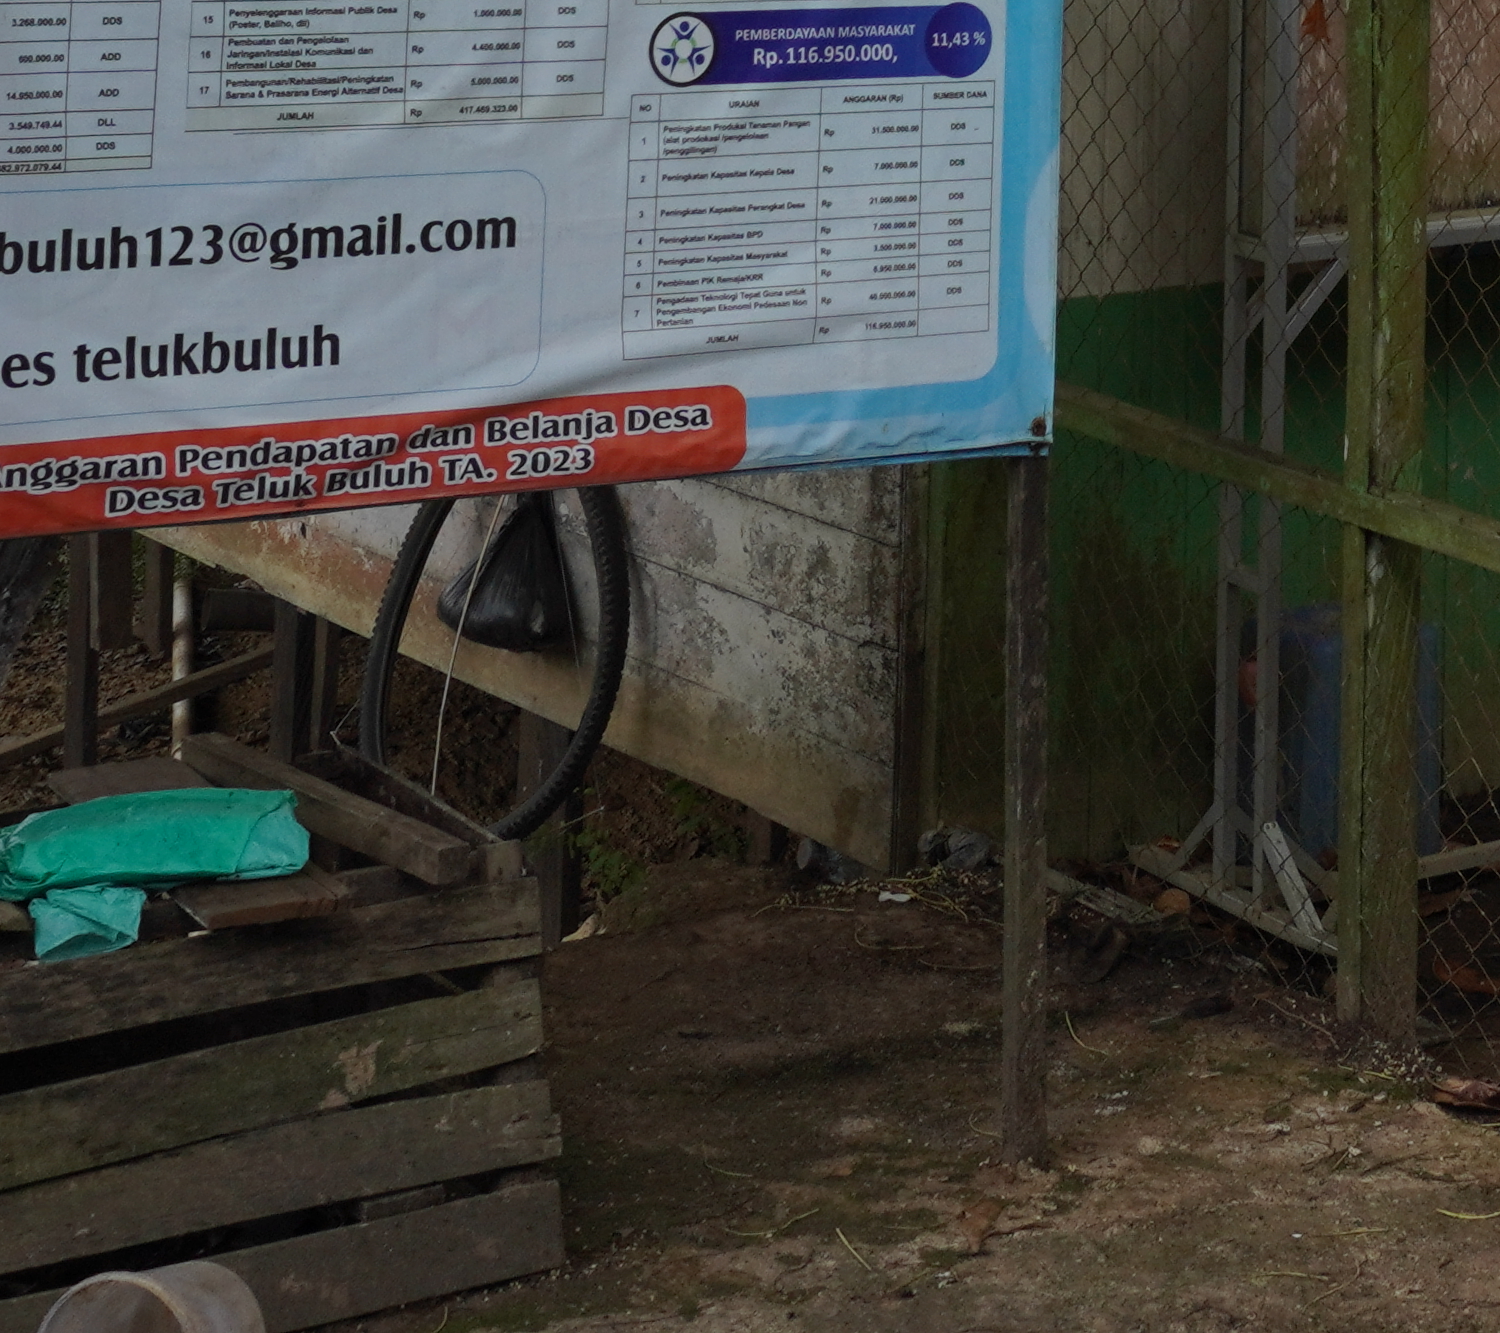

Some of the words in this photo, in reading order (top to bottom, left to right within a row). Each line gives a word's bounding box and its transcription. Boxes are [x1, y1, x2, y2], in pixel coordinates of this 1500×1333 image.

[73, 325, 339, 382] telukbuluh
[177, 432, 399, 476] Pendapatan
[407, 425, 474, 453] dan
[484, 409, 615, 450] Belanja
[624, 404, 710, 435] Desa
